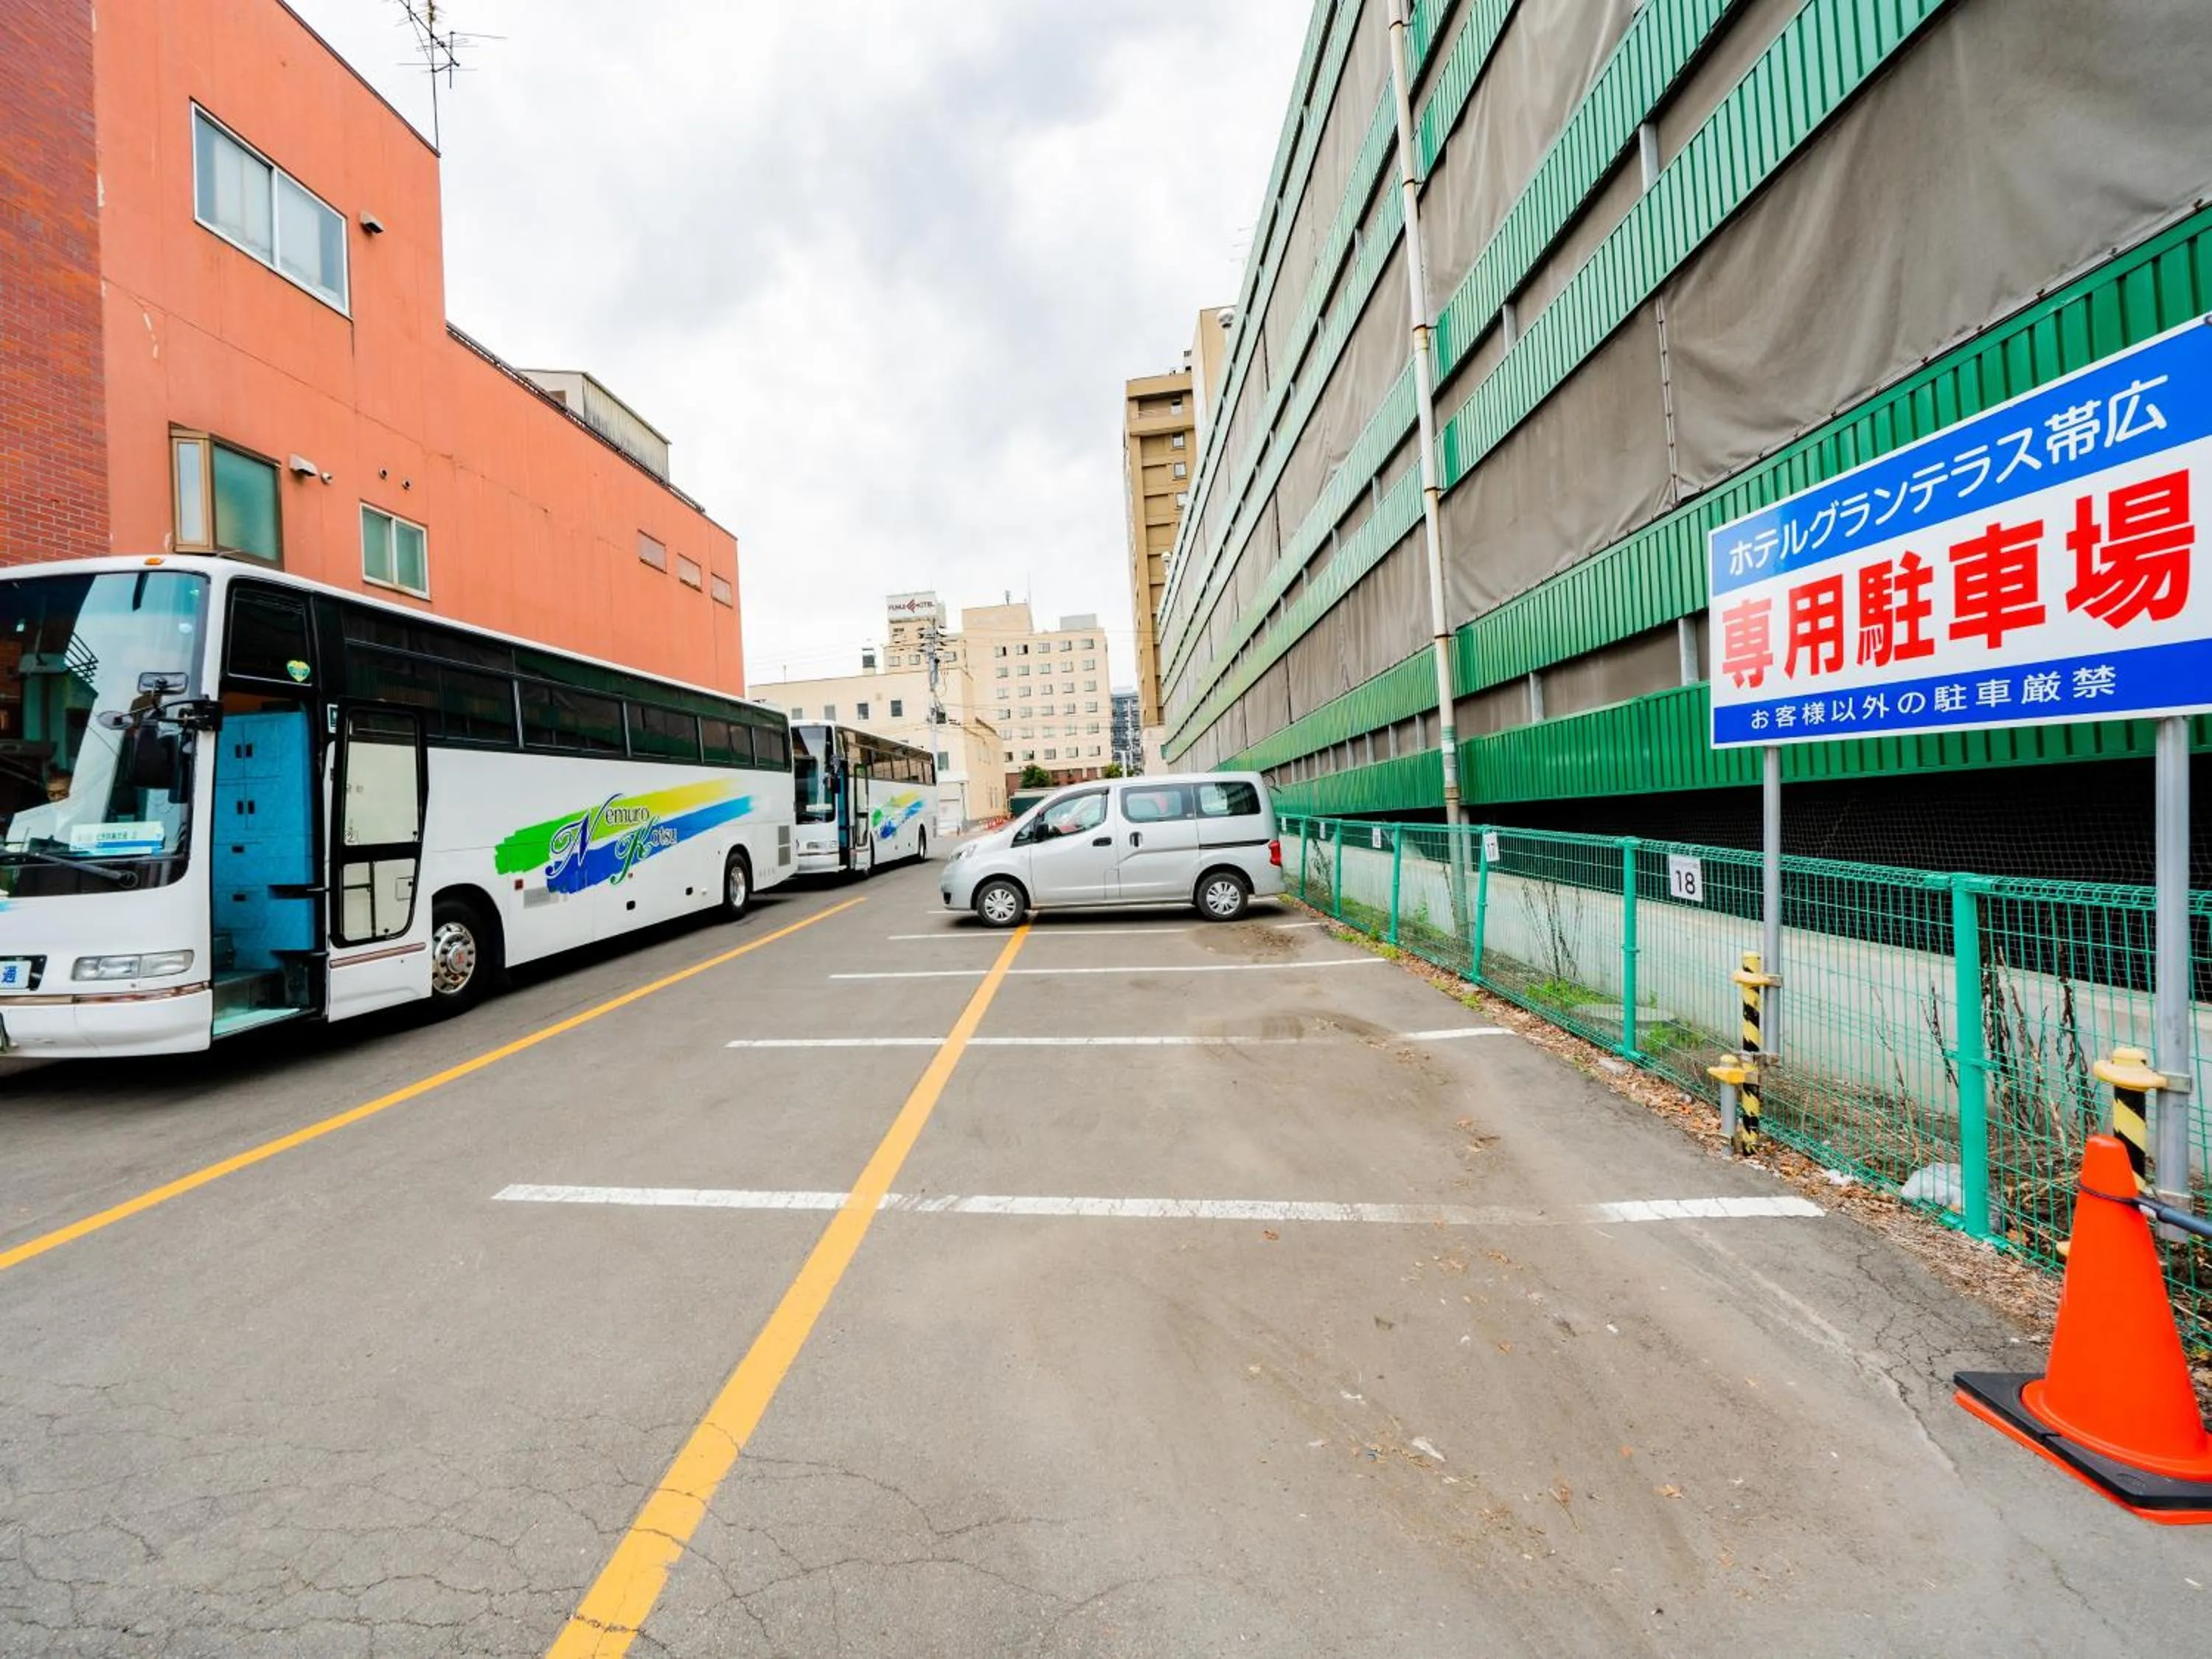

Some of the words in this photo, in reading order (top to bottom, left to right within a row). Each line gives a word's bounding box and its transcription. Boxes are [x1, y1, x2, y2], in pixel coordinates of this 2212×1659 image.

[1729, 374, 2168, 576] ホテルグランテラス帯広
[1722, 468, 2195, 689] 専用駐車場
[1750, 665, 2117, 730] お客様以外の駐車厳禁
[546, 793, 650, 877] Nemuro
[610, 815, 678, 885] Kotsu
[1675, 870, 1695, 895] 18
